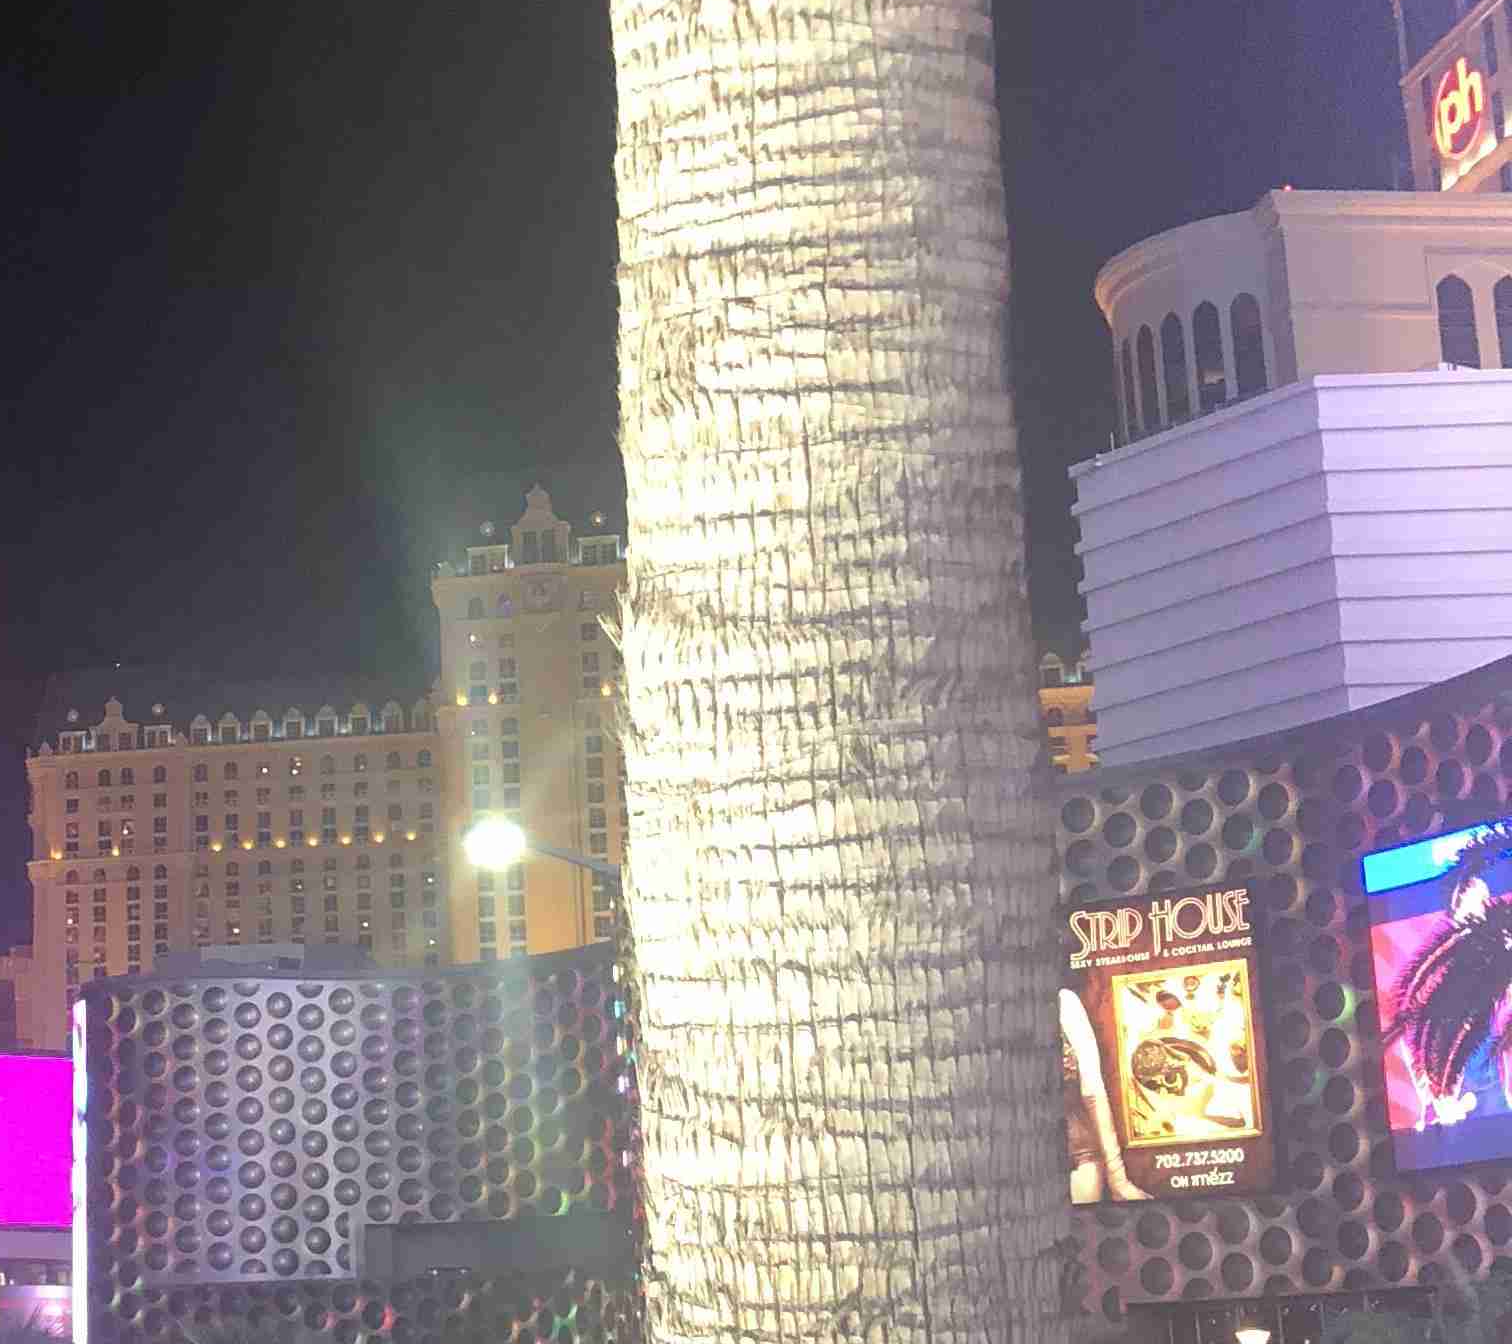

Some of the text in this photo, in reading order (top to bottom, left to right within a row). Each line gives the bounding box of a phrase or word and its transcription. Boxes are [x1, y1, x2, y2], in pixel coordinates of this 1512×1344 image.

[1440, 56, 1482, 154] ph
[1069, 889, 1250, 961] STRIP HOUSE
[1070, 958, 1093, 969] SEXY
[1171, 943, 1214, 957] COCKTAIL
[1217, 936, 1253, 950] LOUNGE
